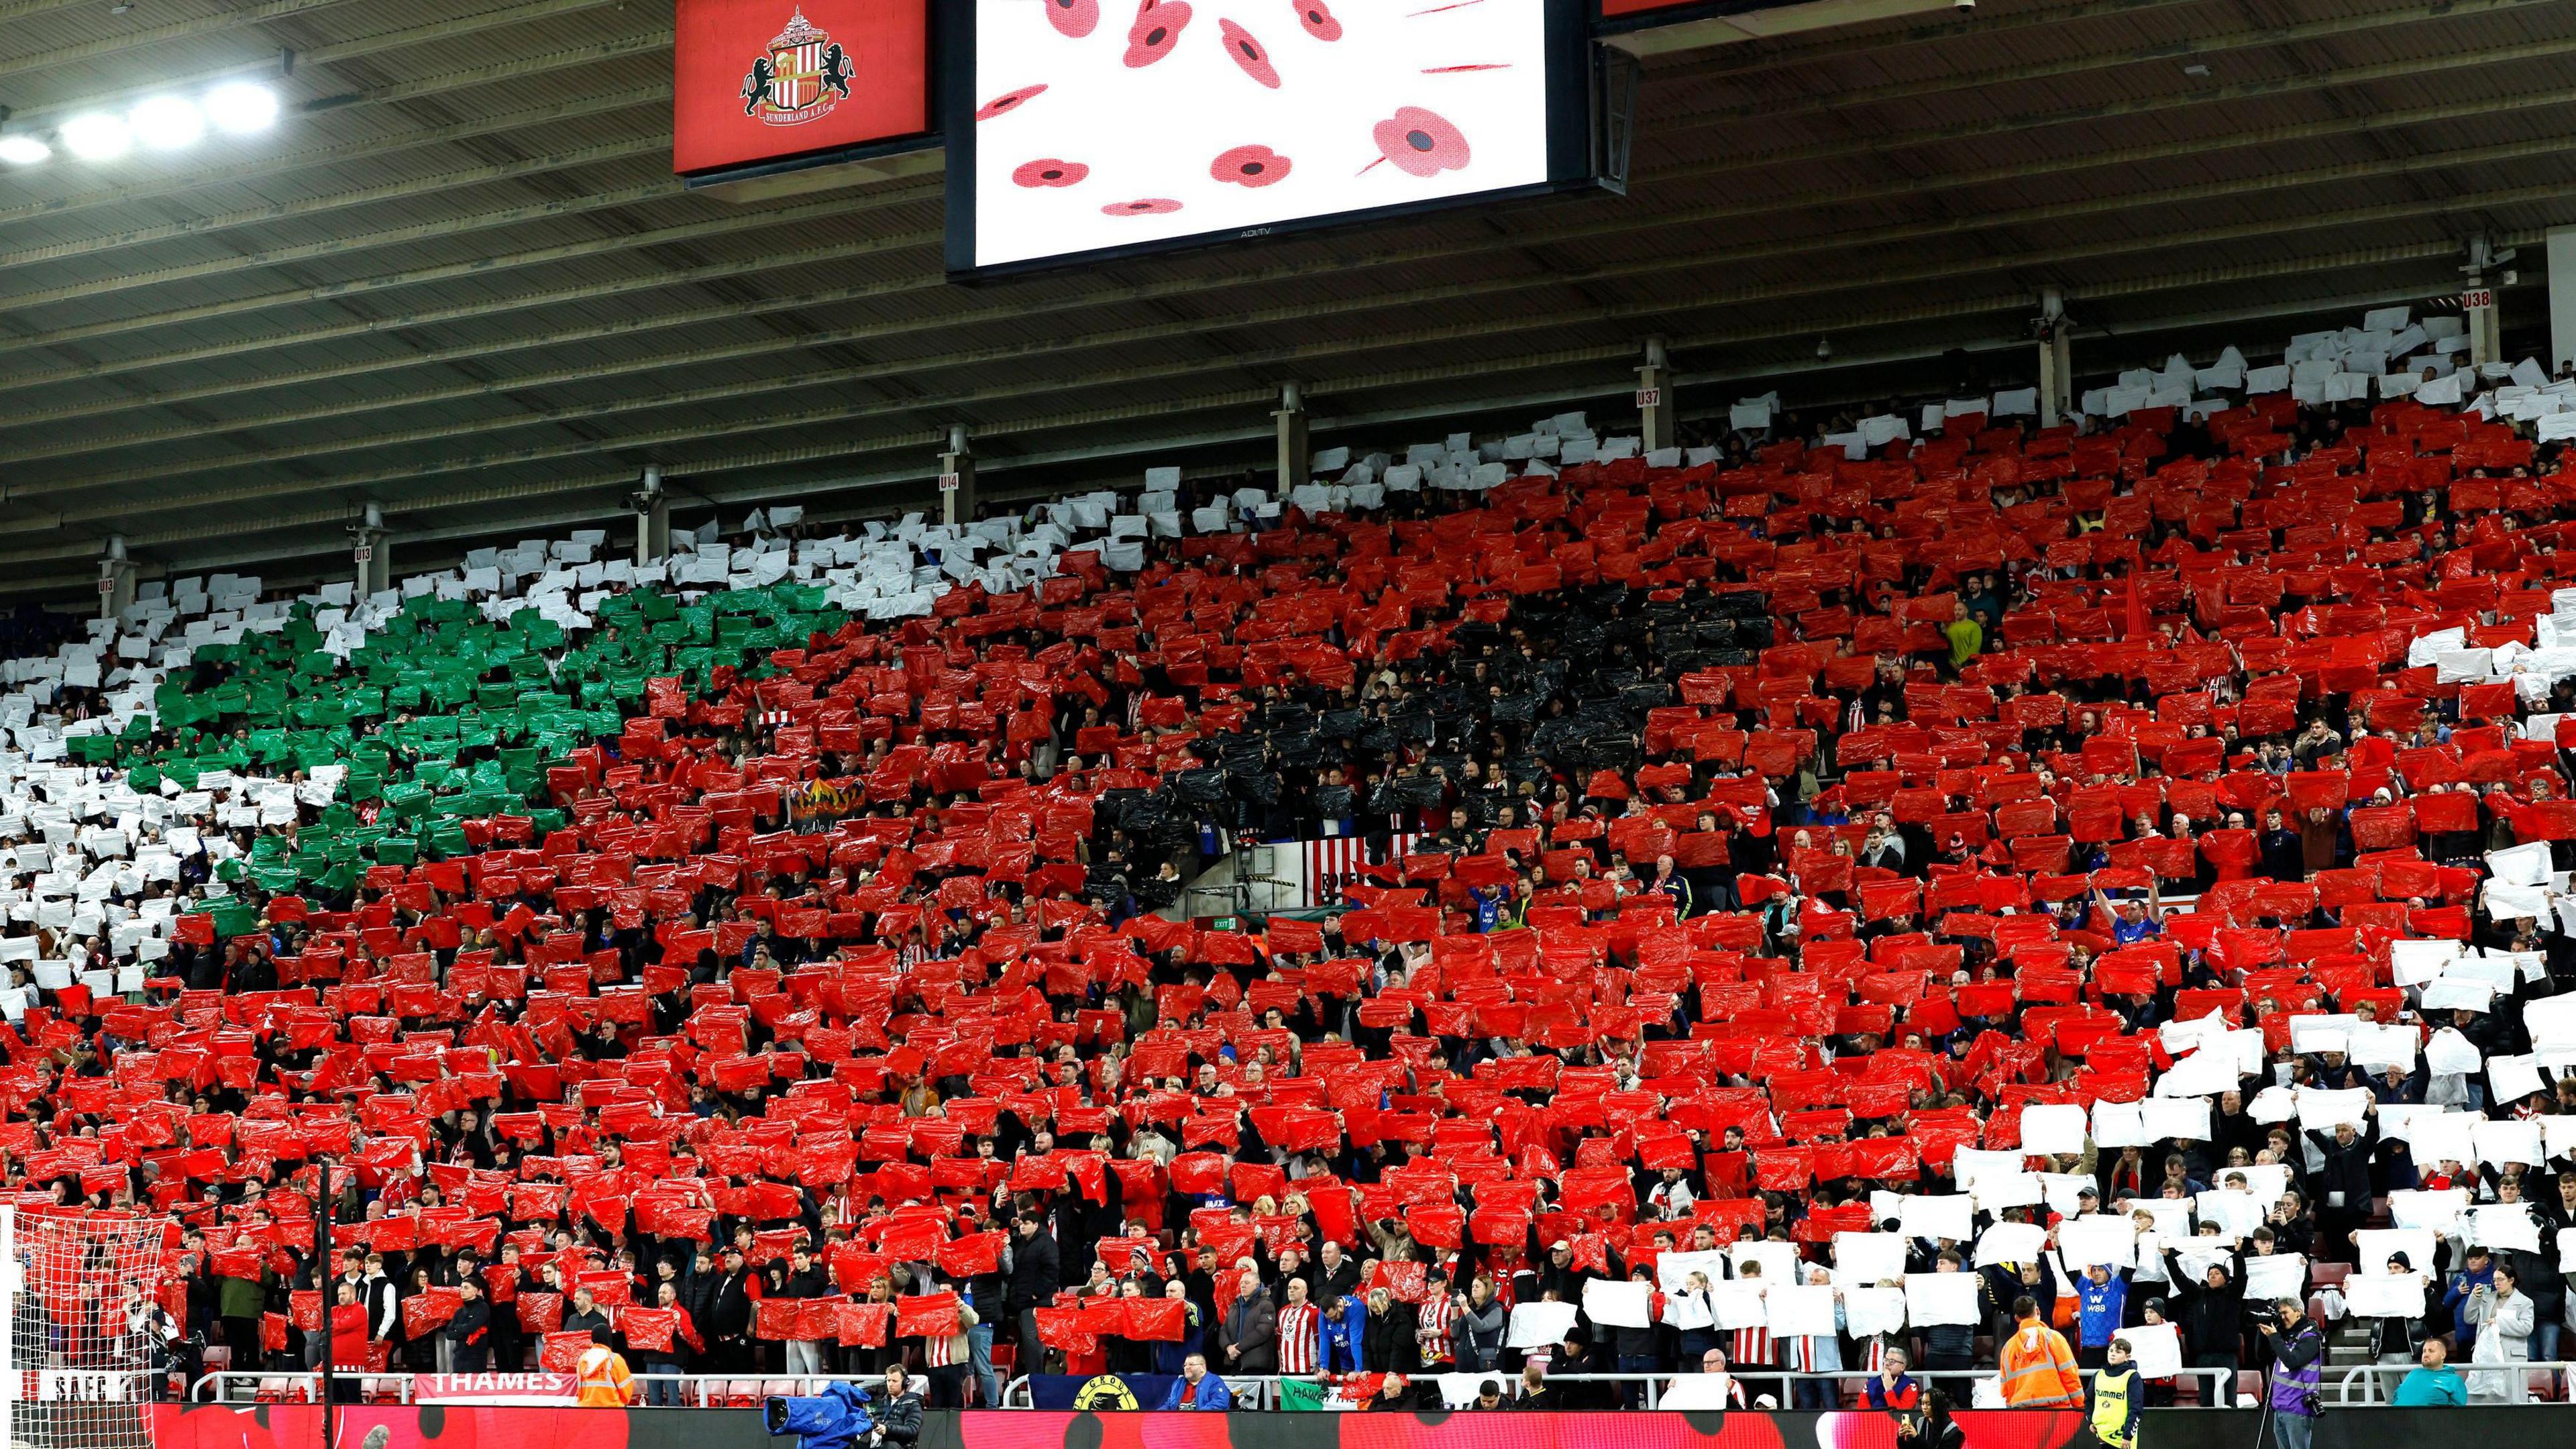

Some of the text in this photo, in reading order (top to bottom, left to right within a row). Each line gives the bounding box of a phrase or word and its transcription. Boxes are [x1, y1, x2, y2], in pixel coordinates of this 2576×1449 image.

[765, 110, 808, 122] SUNDERLAND
[2463, 291, 2489, 308] U38
[1638, 390, 1659, 405] U37
[941, 475, 957, 488] U14
[356, 548, 370, 561] U13
[100, 580, 113, 591] U13
[2087, 1304, 2106, 1312] W88
[430, 1373, 564, 1393] THAMES
